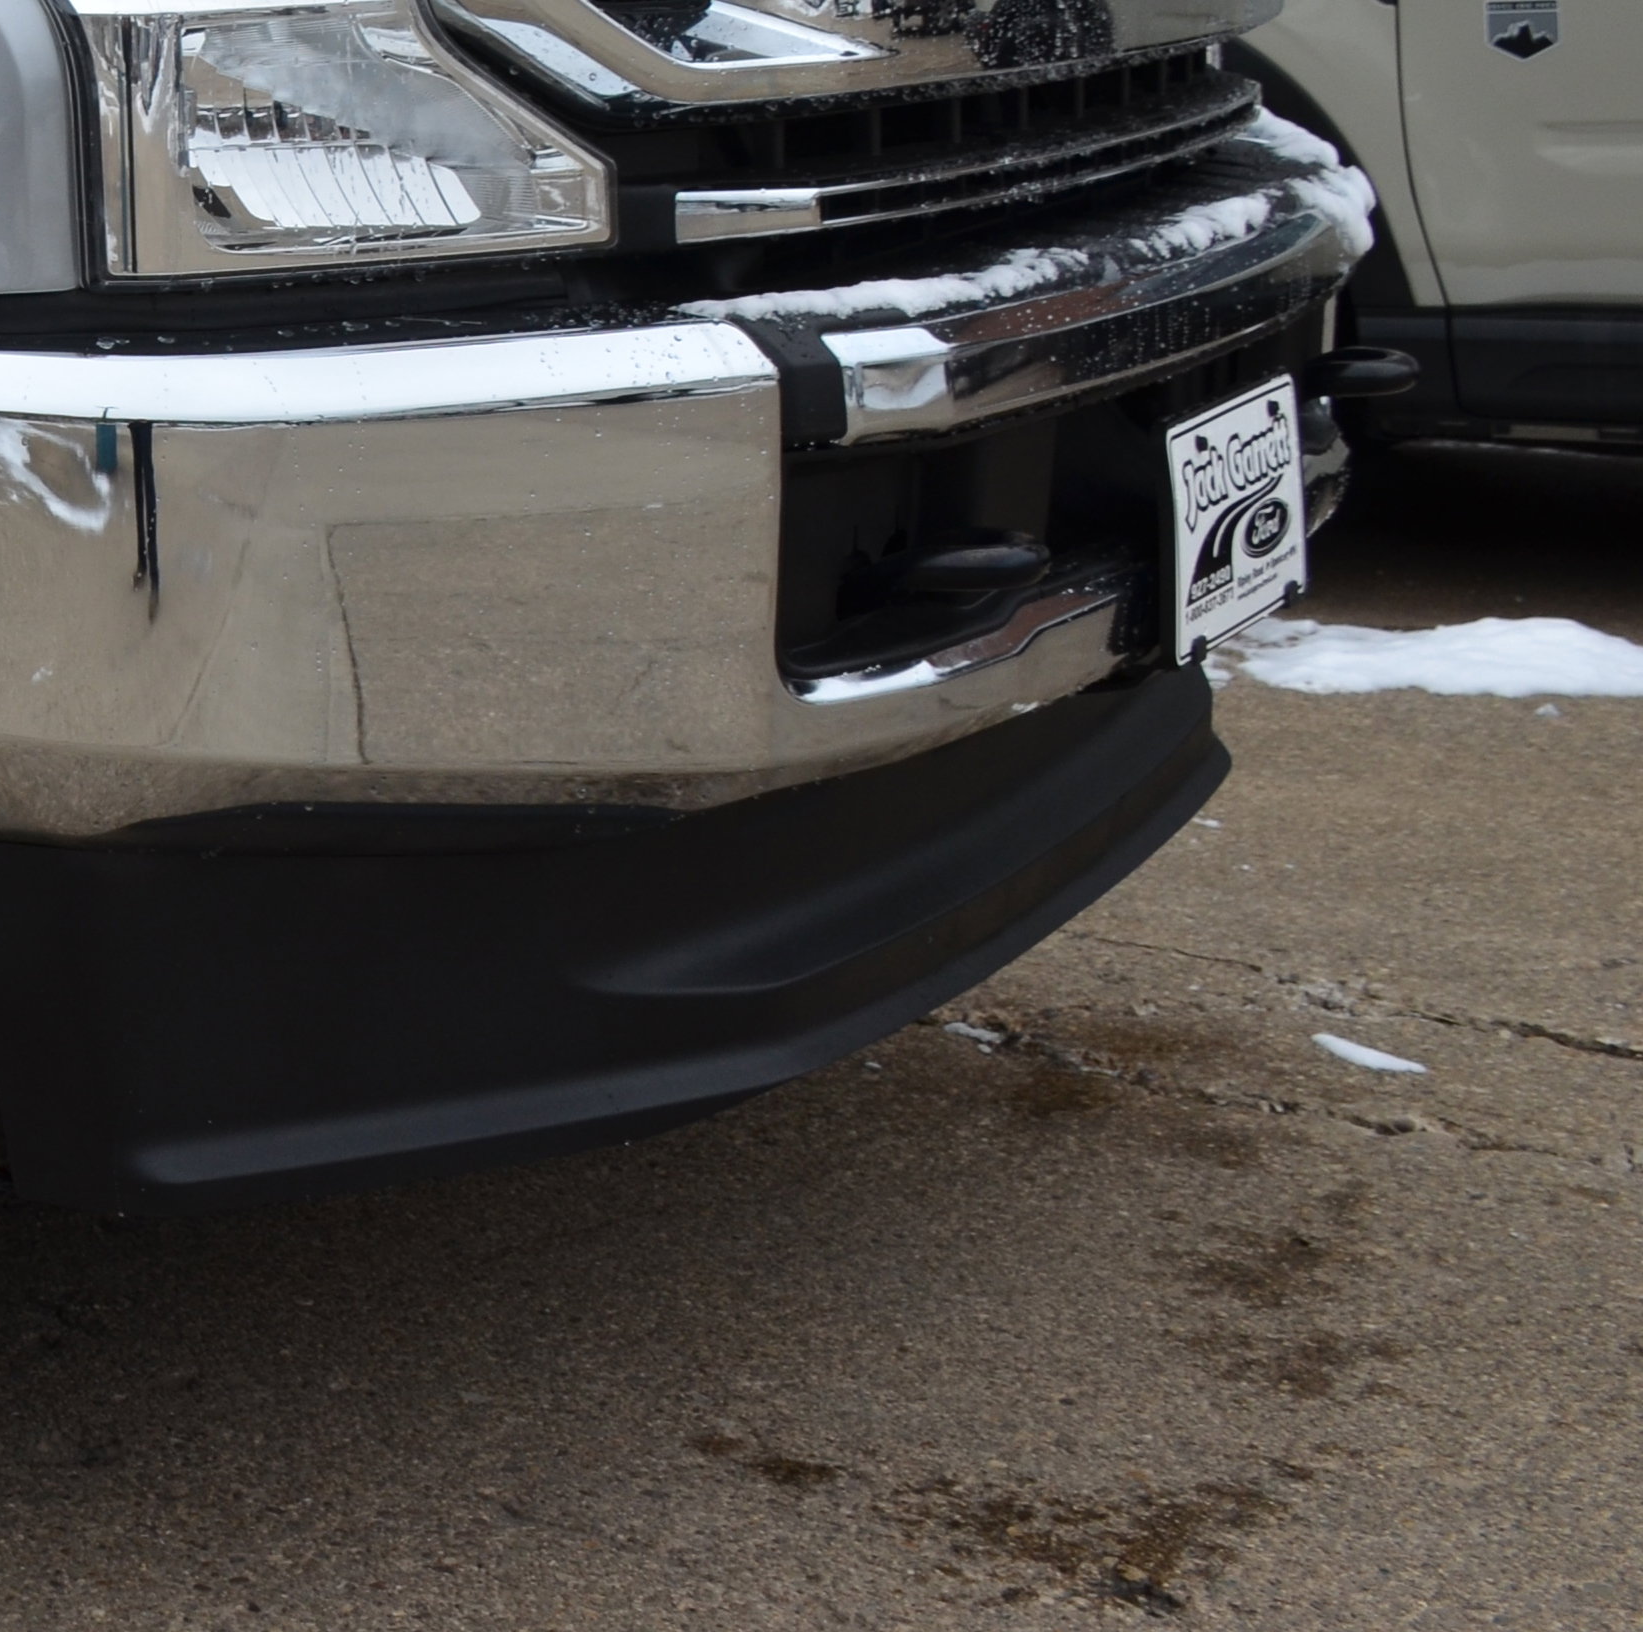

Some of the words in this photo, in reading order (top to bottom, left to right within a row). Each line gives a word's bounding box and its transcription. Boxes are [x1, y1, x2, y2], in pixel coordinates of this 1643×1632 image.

[1183, 445, 1229, 534] Jack
[1225, 415, 1291, 492] Garrett
[1250, 506, 1282, 546] Ford
